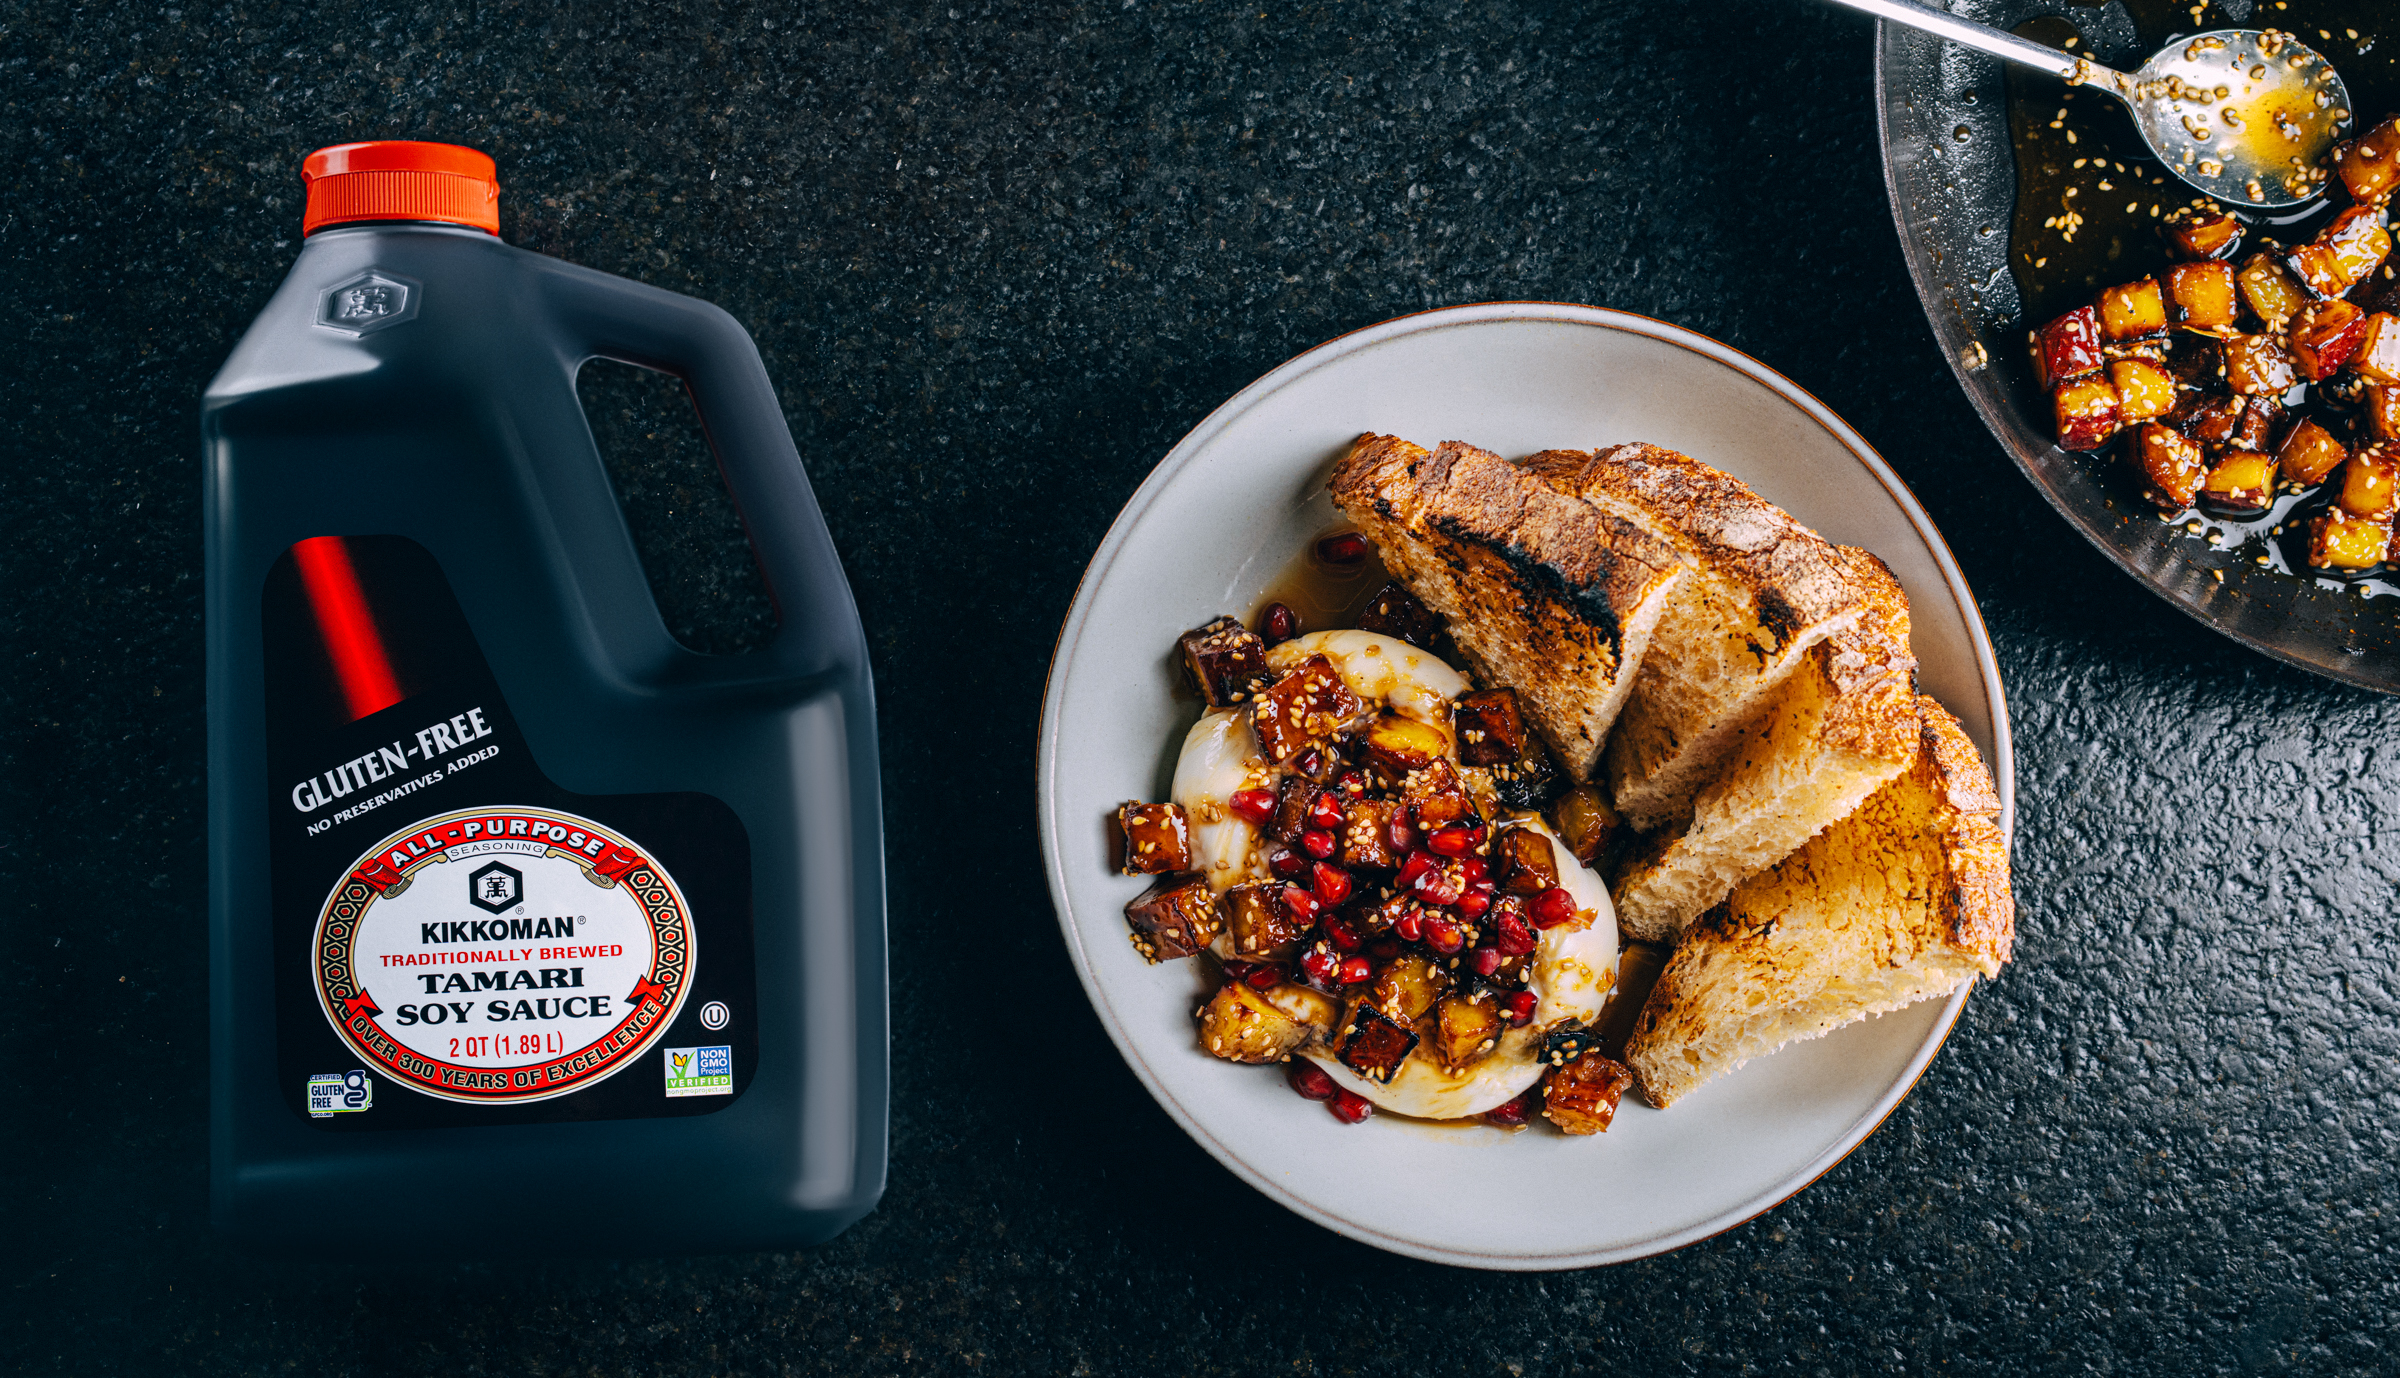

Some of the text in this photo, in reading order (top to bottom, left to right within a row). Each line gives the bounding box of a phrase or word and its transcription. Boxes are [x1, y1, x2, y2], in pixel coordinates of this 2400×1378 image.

[292, 706, 493, 813] GLUTEN-FREE
[306, 744, 500, 837] NO PRESERVATIVES ADDED
[450, 842, 544, 857] SEASONING
[379, 944, 624, 967] TRADITIONALLY BREWED
[417, 967, 585, 994] TAMARI
[396, 995, 612, 1026] SOY SAUCE
[352, 1000, 661, 1088] OVER 300 YEARS OF EXCELLENCE
[449, 1031, 564, 1058] 2 QT (1.89 L)
[700, 1049, 727, 1059] NON
[700, 1058, 728, 1068] GMO
[700, 1067, 728, 1076] Project
[670, 1077, 728, 1087] VERIFIED
[311, 1084, 344, 1096] GLUTEN
[667, 1087, 731, 1095] nongmoproject.org
[311, 1097, 332, 1109] FREE
